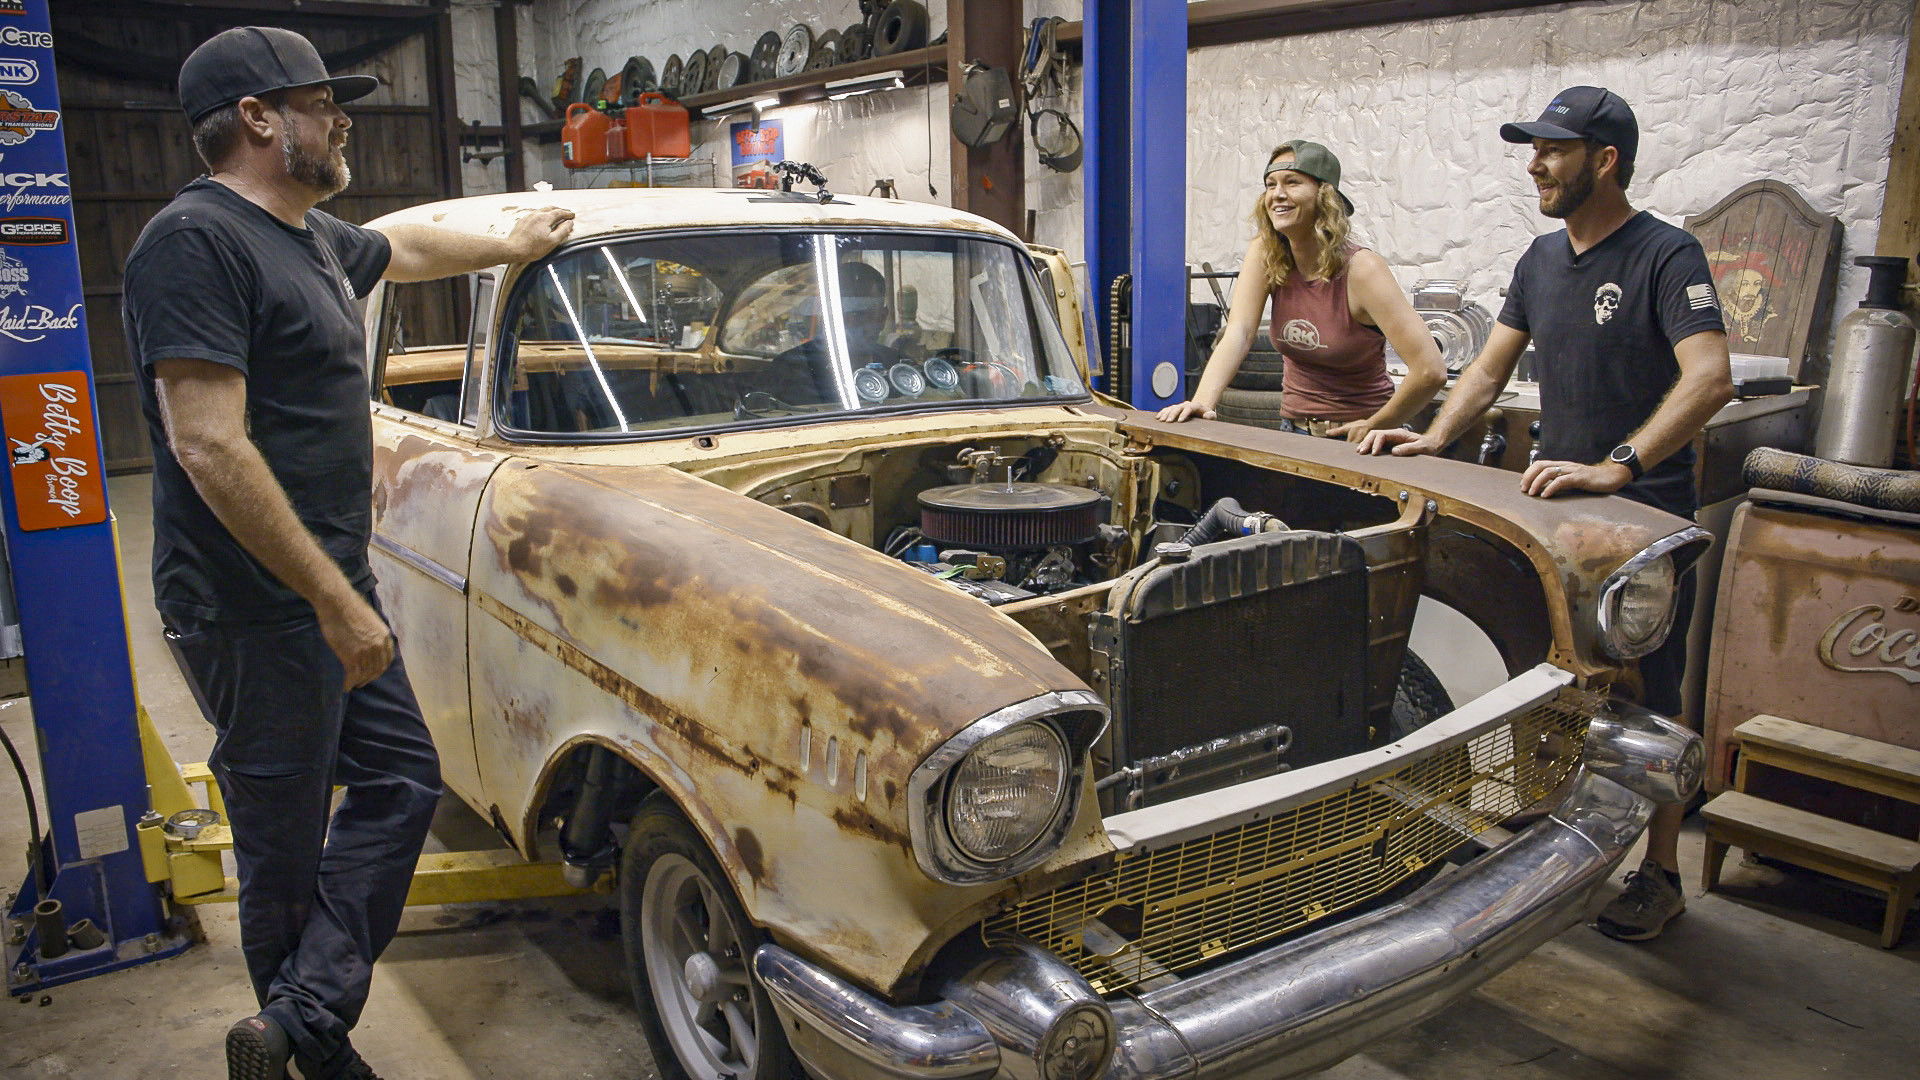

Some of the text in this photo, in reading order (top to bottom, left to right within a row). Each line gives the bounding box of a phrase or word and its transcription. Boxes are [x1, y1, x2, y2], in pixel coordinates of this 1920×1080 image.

[0, 267, 29, 282] OSS
[35, 383, 88, 518] Betty Boop
